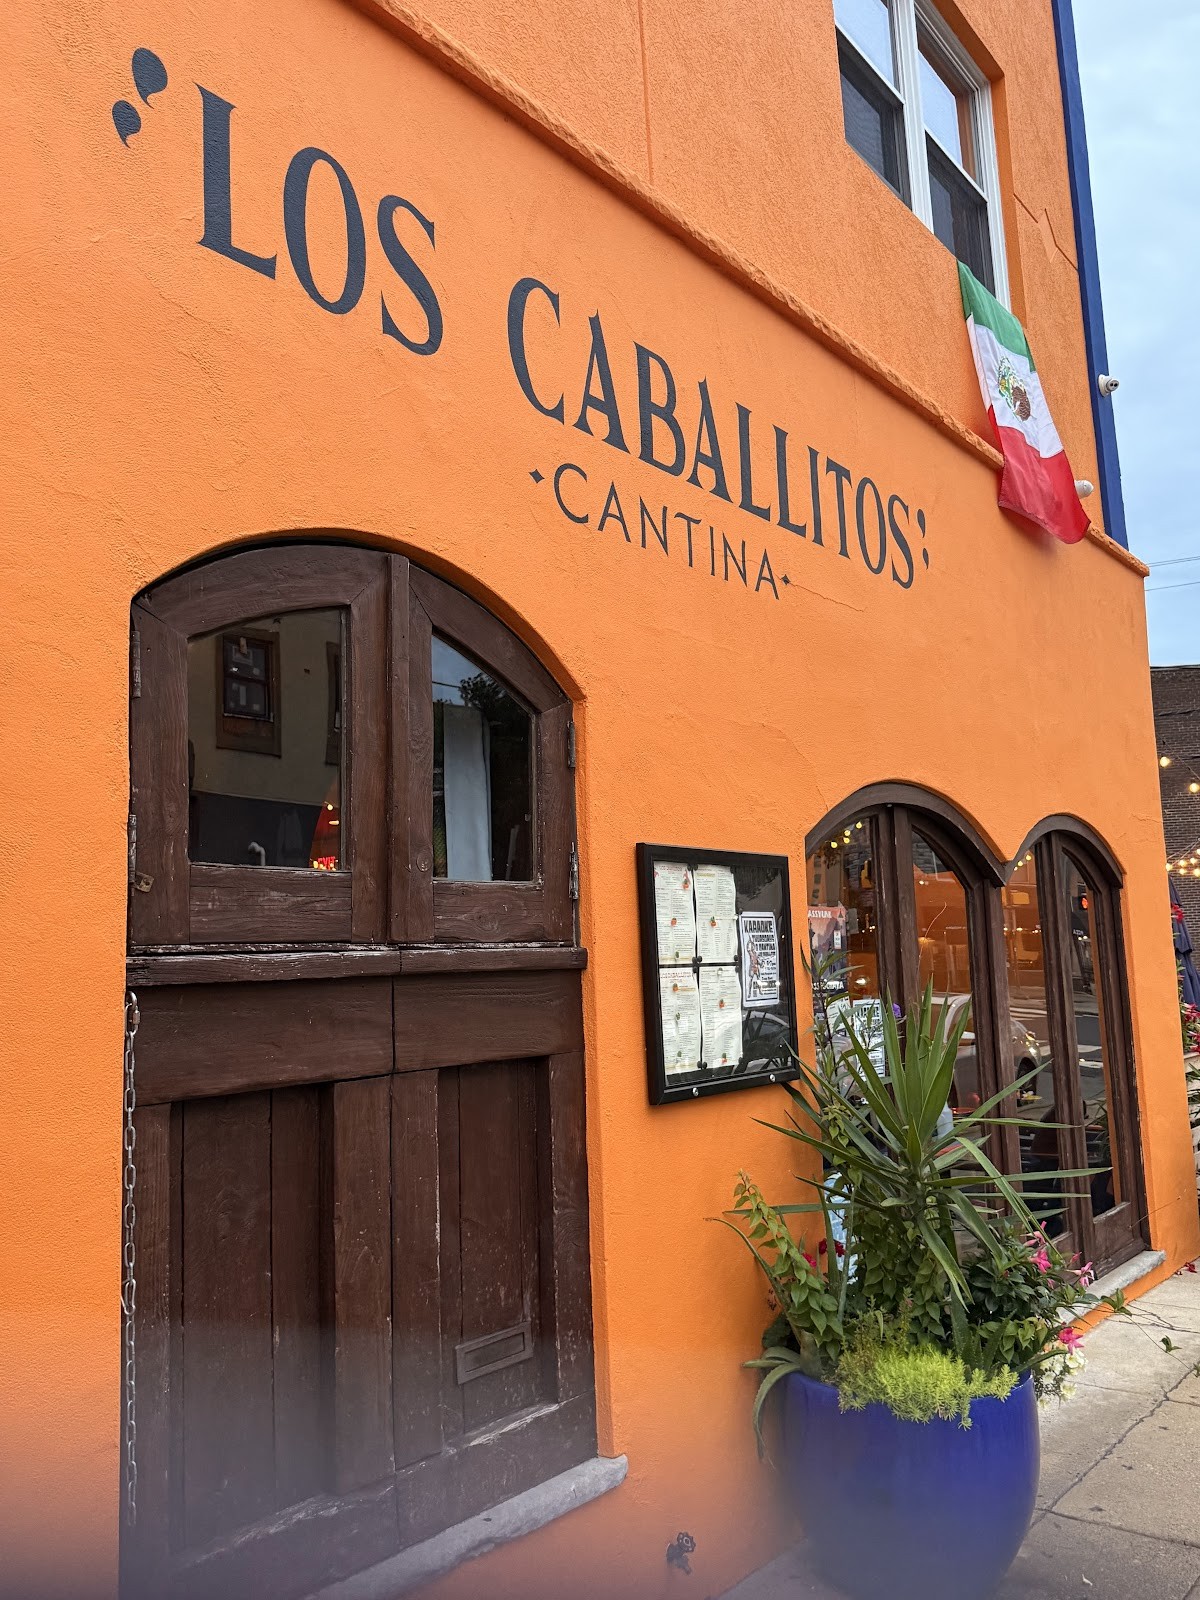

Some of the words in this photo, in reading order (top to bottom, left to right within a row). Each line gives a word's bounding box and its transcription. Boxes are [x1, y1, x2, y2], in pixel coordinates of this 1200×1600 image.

[193, 82, 443, 356] LOS
[507, 277, 915, 590] CABALLITOS
[553, 463, 780, 601] CANTINA
[744, 920, 773, 933] KARAOKE
